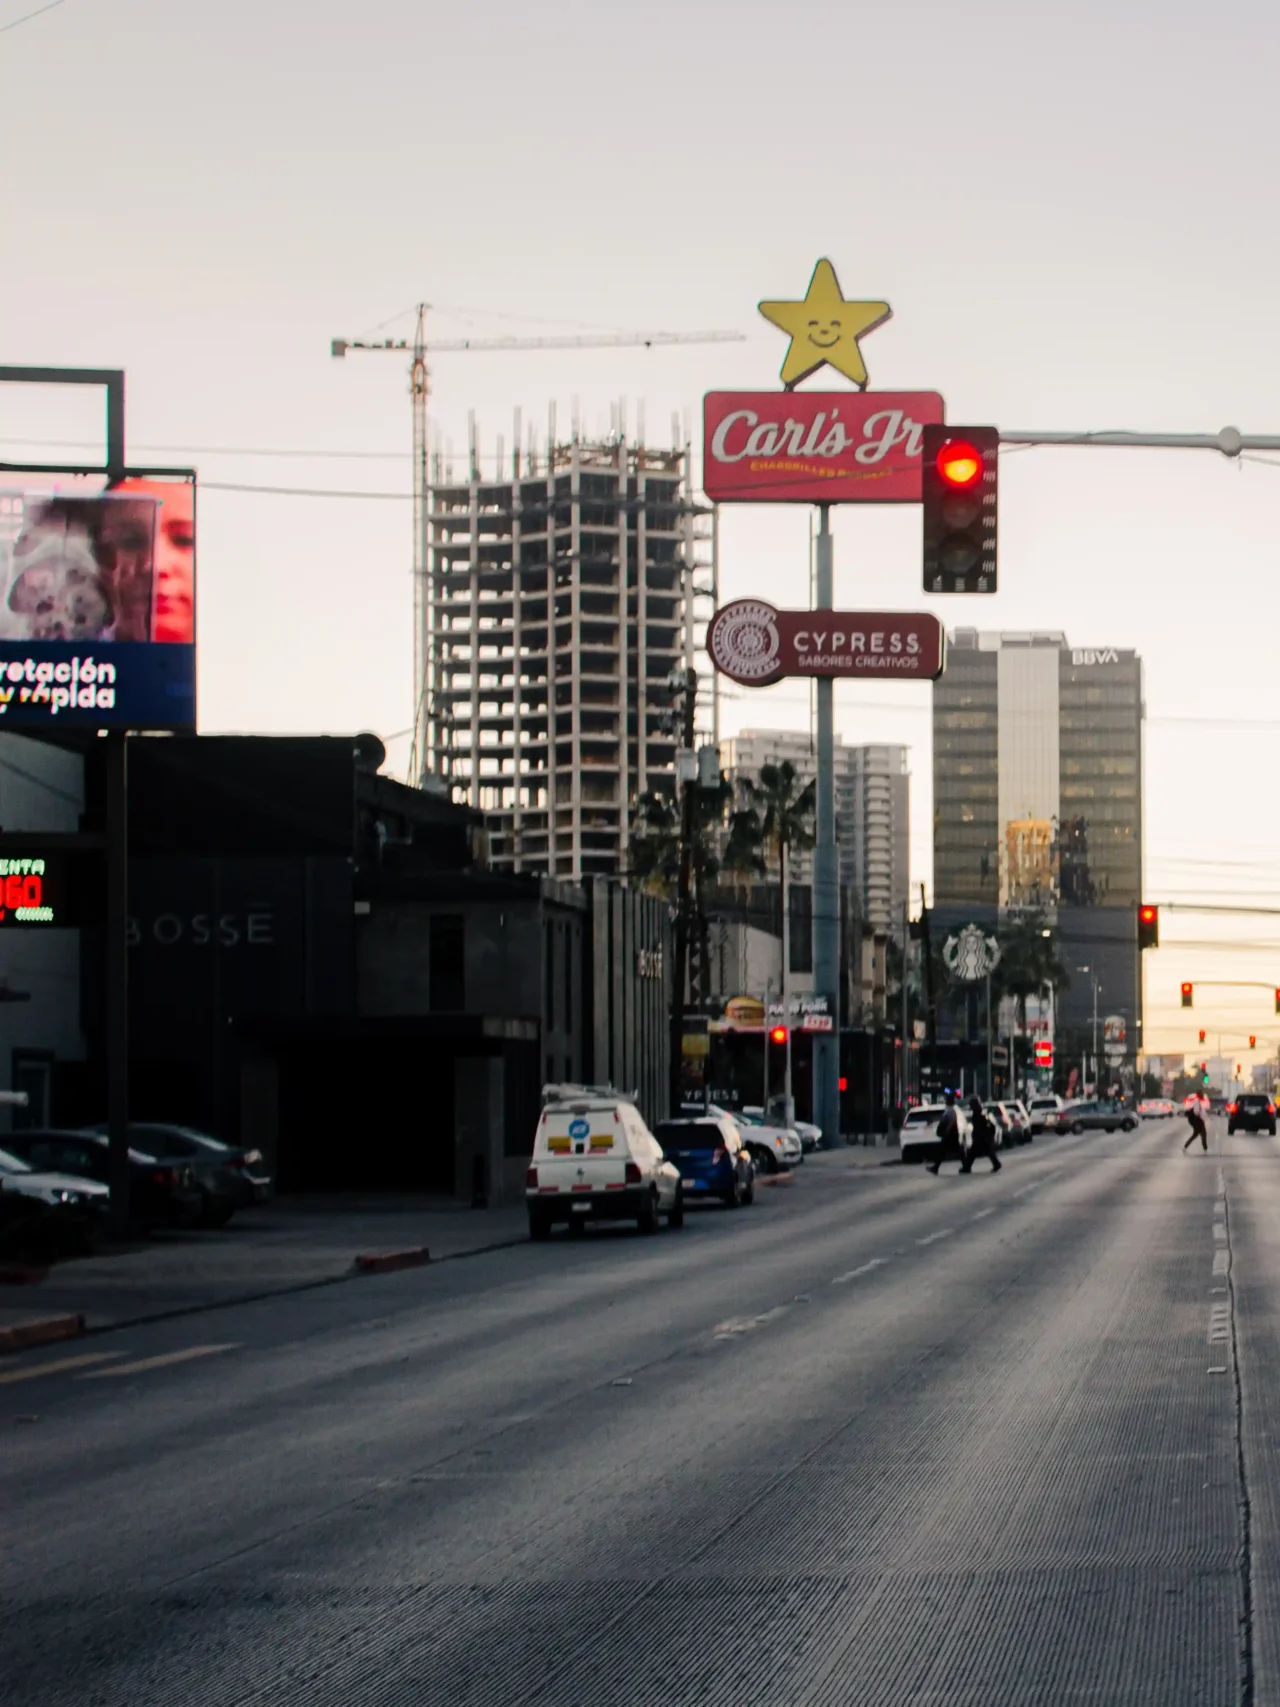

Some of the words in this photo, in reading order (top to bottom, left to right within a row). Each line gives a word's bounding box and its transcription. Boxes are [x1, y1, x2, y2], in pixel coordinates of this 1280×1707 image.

[711, 408, 853, 463] Carl's
[793, 631, 919, 654] CYPRESS
[798, 654, 853, 668] SABORES
[855, 655, 919, 669] CREATIVOS
[1073, 648, 1119, 666] BBVA
